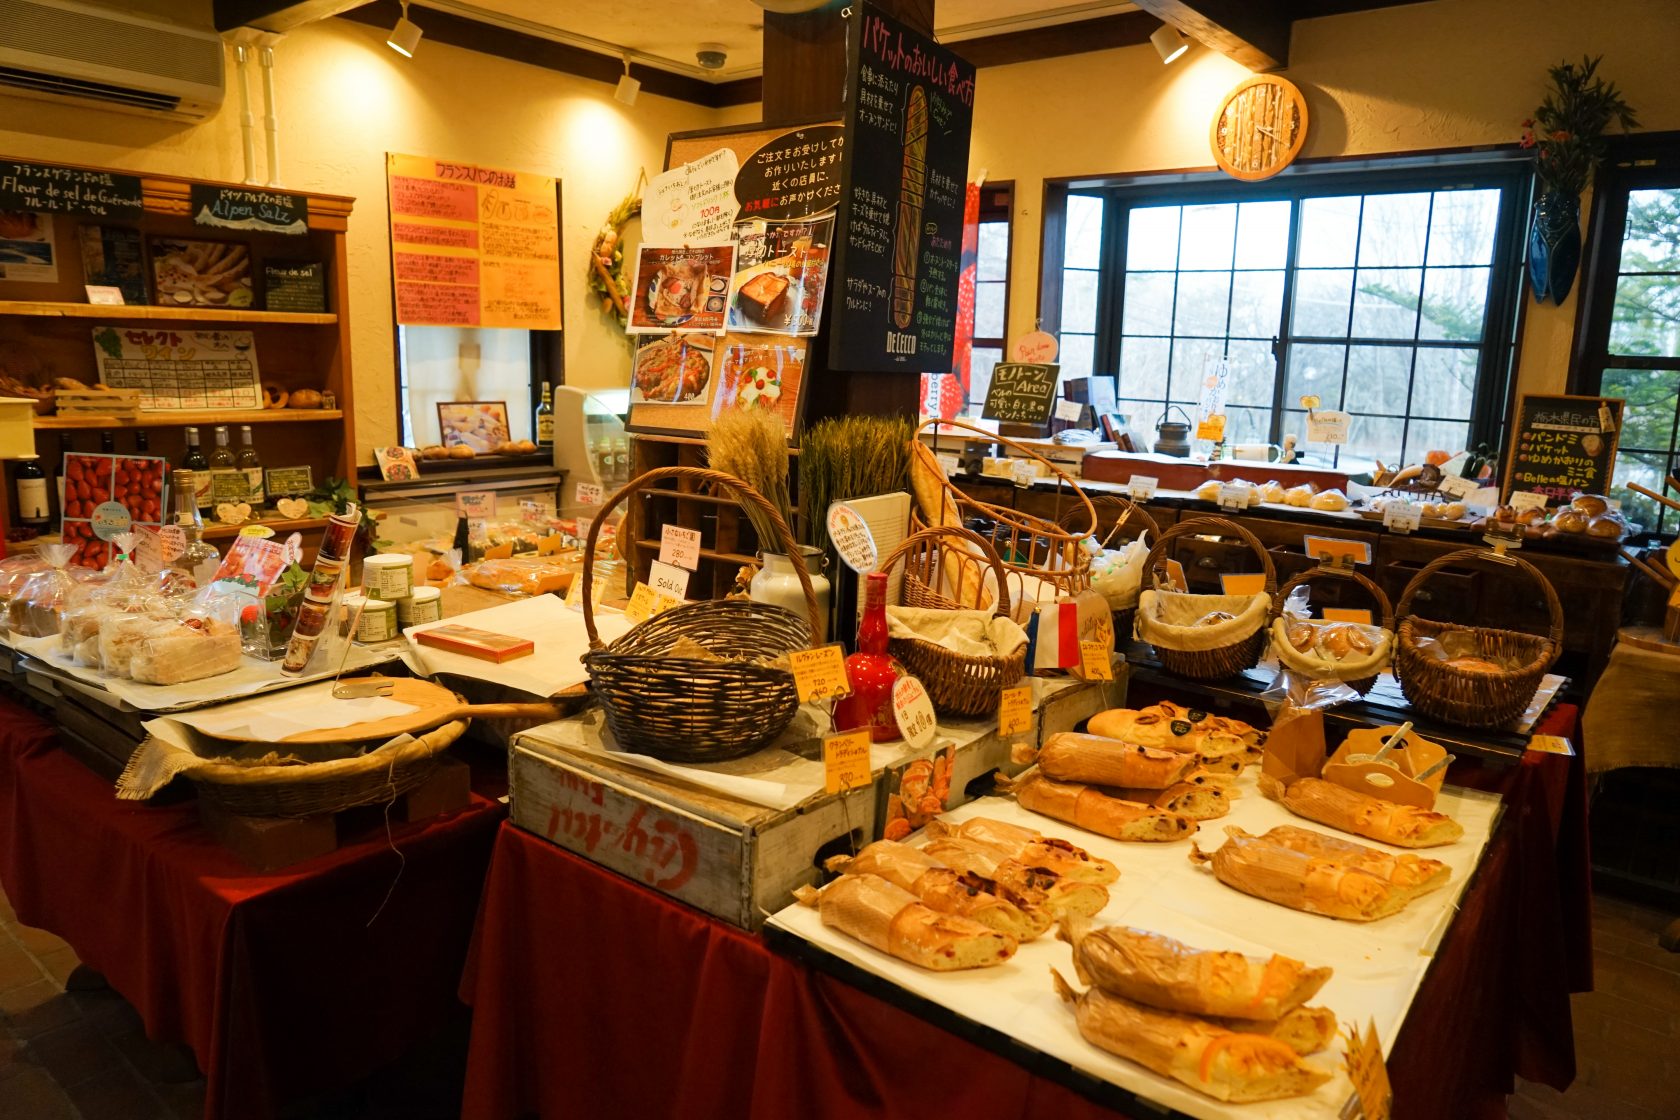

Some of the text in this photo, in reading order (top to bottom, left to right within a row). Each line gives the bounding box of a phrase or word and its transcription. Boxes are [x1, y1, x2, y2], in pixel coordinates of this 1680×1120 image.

[863, 14, 976, 107] バケットのおいしい食べ方
[2, 176, 41, 194] Fleur
[45, 182, 60, 197] de
[63, 184, 79, 200] sel
[83, 188, 97, 201] de
[211, 199, 291, 223] Alpen Salz
[288, 266, 299, 276] de
[300, 268, 313, 277] sel
[124, 329, 183, 348] セレクト
[140, 344, 196, 361] ワイン
[998, 366, 1044, 381] モノトーン
[1015, 380, 1047, 394] Area
[1530, 432, 1579, 445] パンドミ
[1529, 443, 1569, 455] バケット
[1528, 453, 1595, 467] ゆめかおりの
[657, 577, 673, 591] Sold
